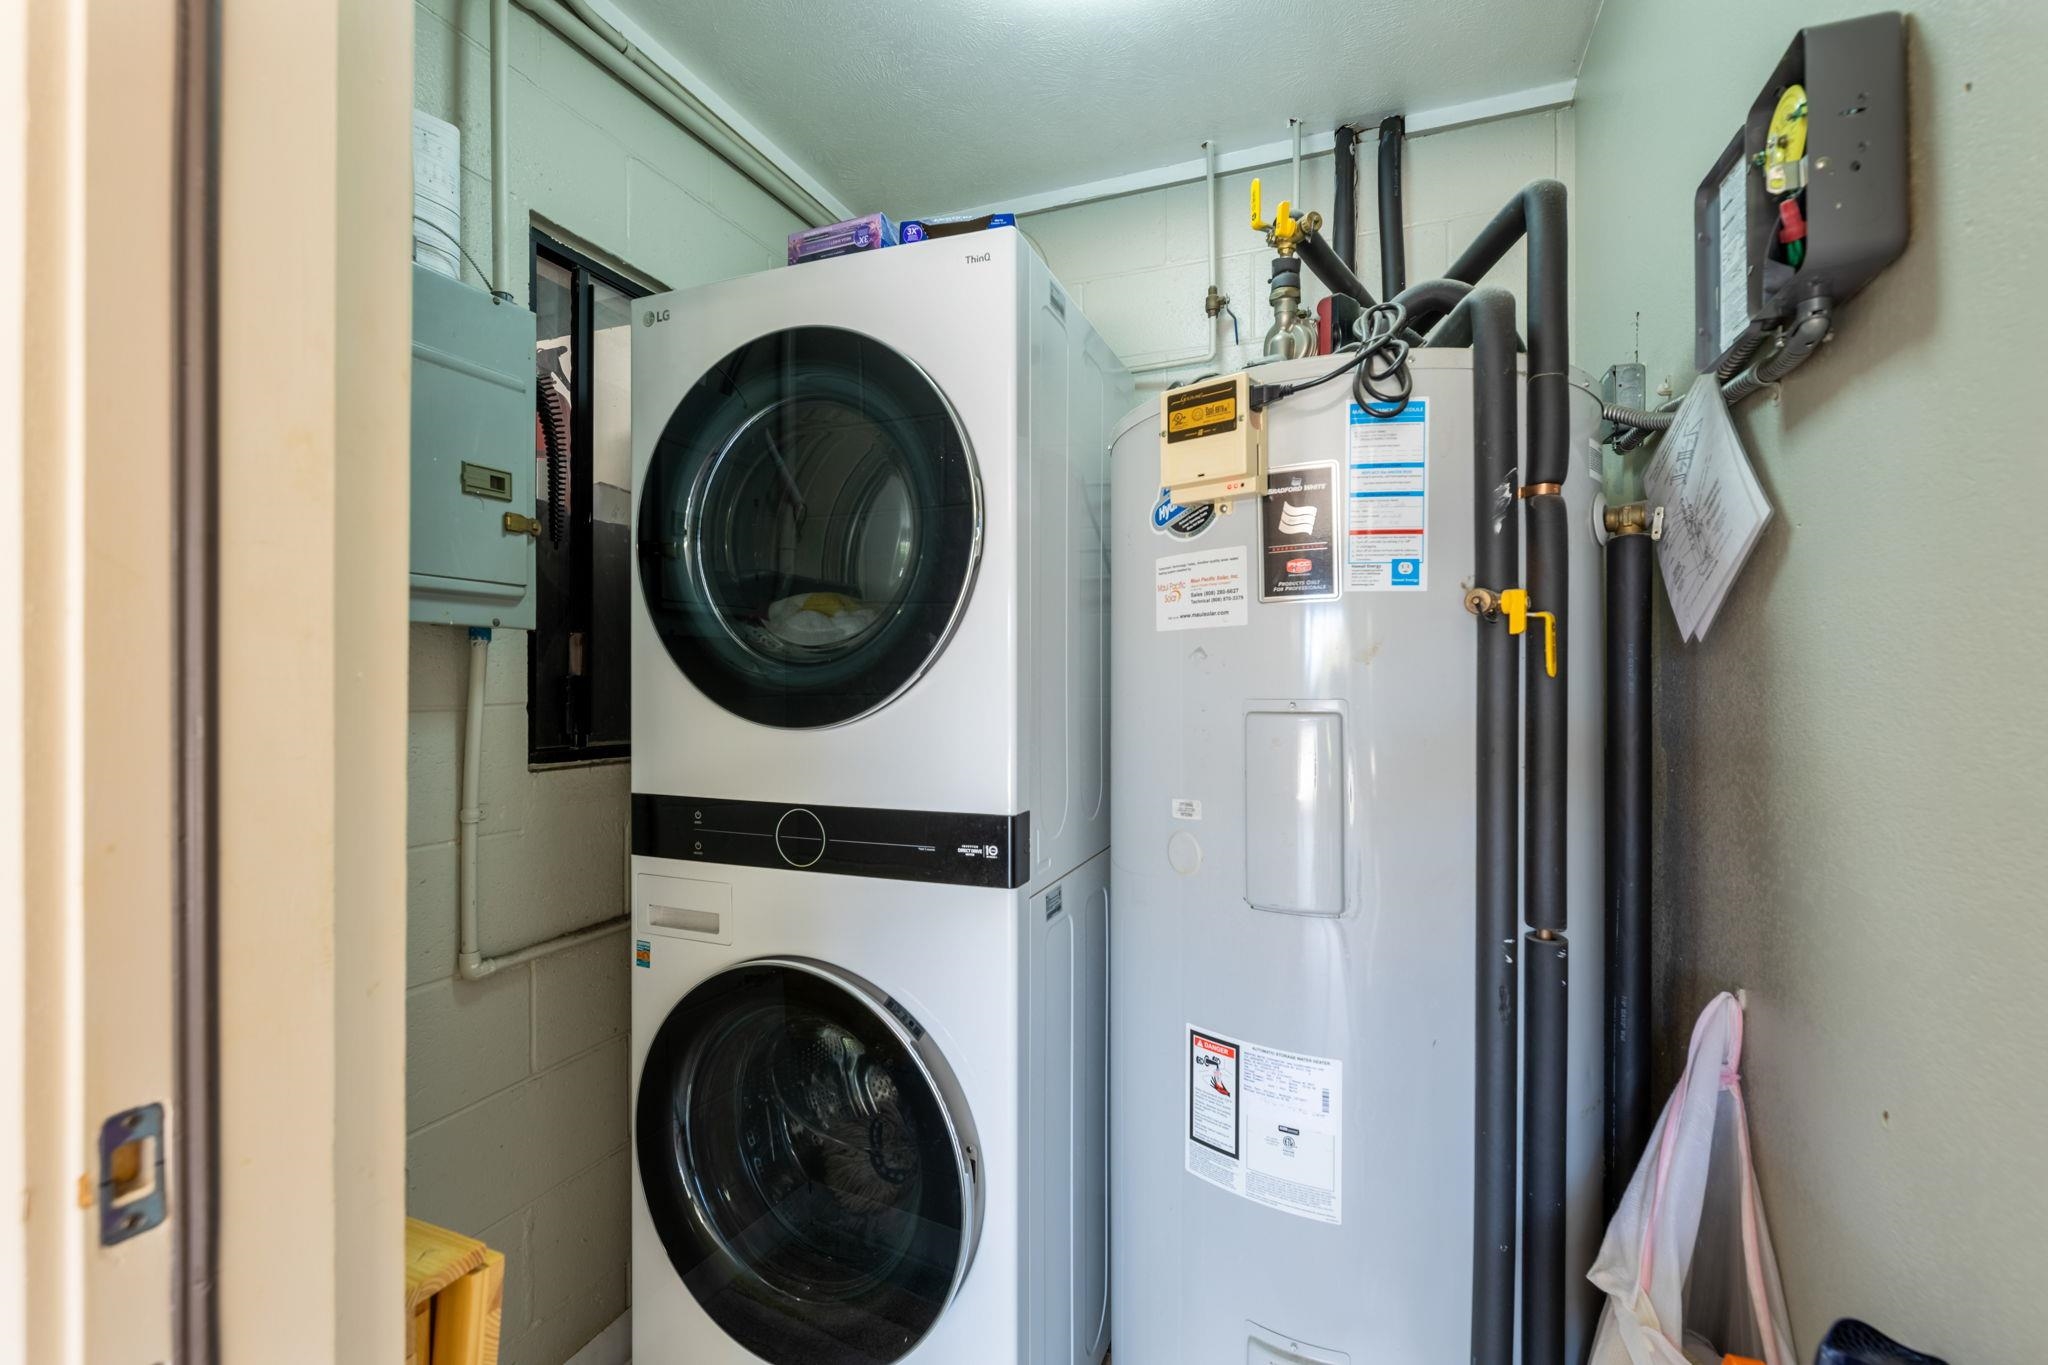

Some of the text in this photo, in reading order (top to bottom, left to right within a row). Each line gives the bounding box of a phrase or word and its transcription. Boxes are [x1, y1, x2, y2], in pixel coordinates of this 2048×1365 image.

[965, 252, 991, 264] ThinQ
[656, 310, 670, 323] LG
[1203, 1041, 1230, 1055] DANGER
